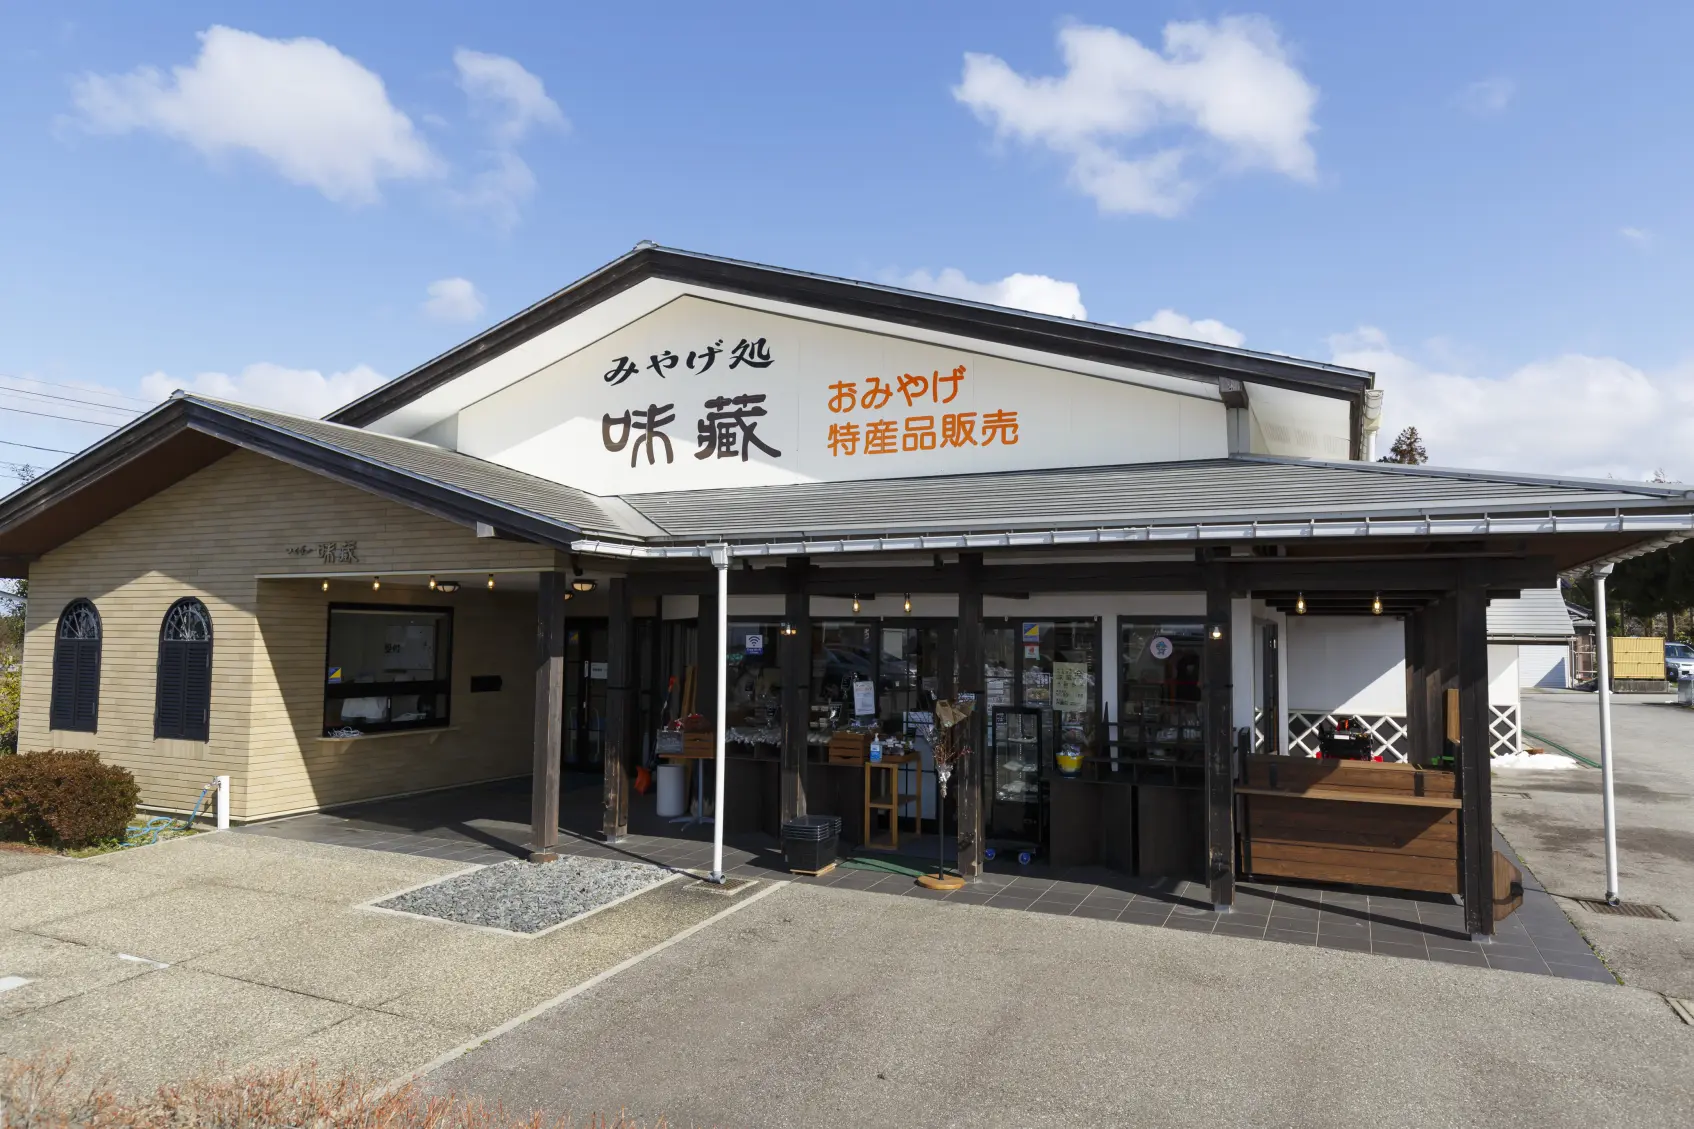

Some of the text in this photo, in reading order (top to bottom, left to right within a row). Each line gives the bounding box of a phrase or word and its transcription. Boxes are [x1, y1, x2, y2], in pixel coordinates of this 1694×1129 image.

[604, 337, 775, 386] みやげ処
[827, 365, 966, 413] おみやげ
[827, 409, 1018, 456] 特産品販売
